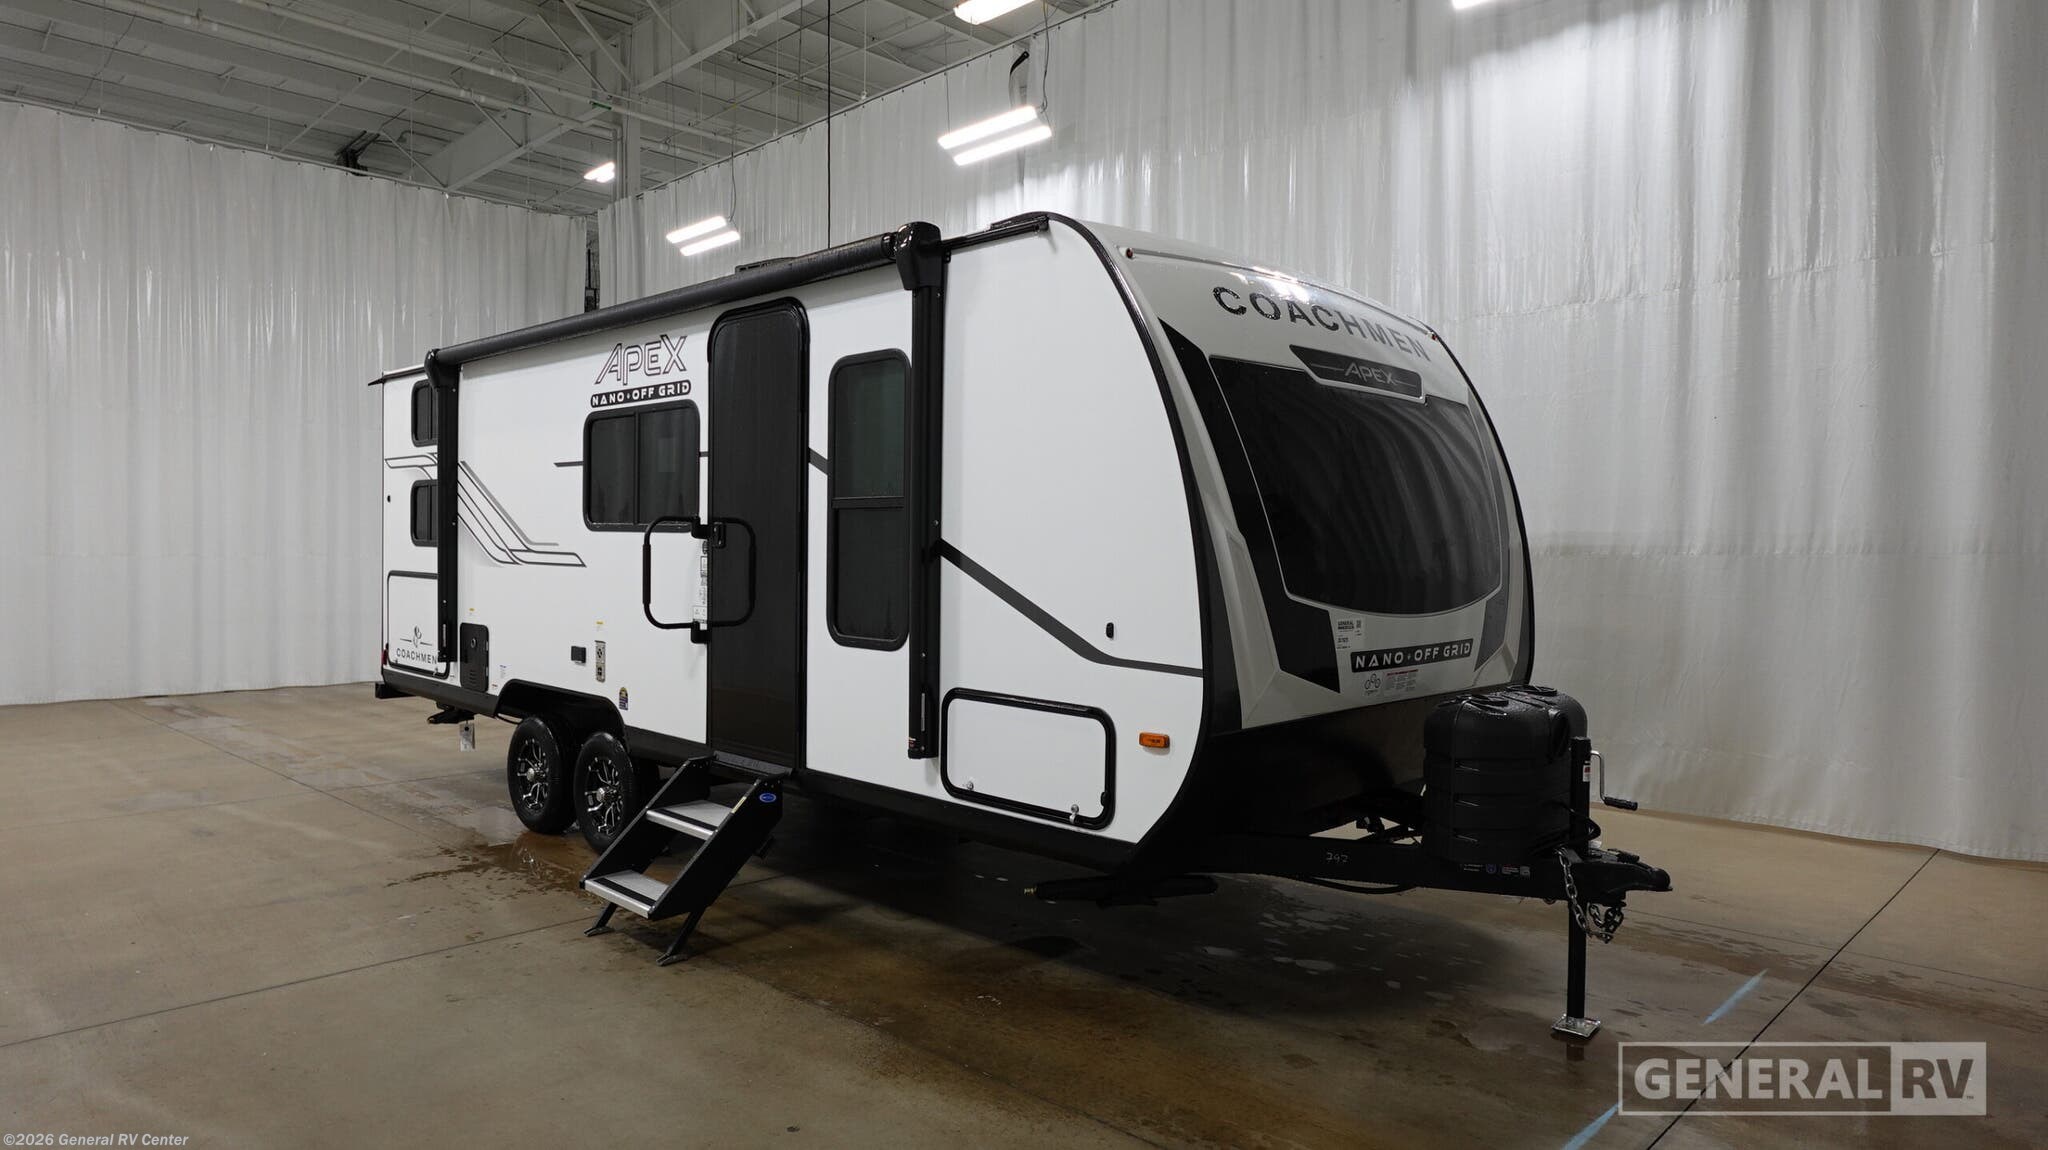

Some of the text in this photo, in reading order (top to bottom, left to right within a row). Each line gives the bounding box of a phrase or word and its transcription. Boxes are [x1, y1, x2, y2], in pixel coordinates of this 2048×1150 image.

[1213, 286, 1431, 361] COACHMEN
[594, 334, 688, 386] APEX
[1345, 361, 1398, 385] APEX
[592, 382, 690, 406] NANO OFF GRID
[396, 647, 437, 664] COACHMEN
[1355, 642, 1471, 669] NANO OFF GRID
